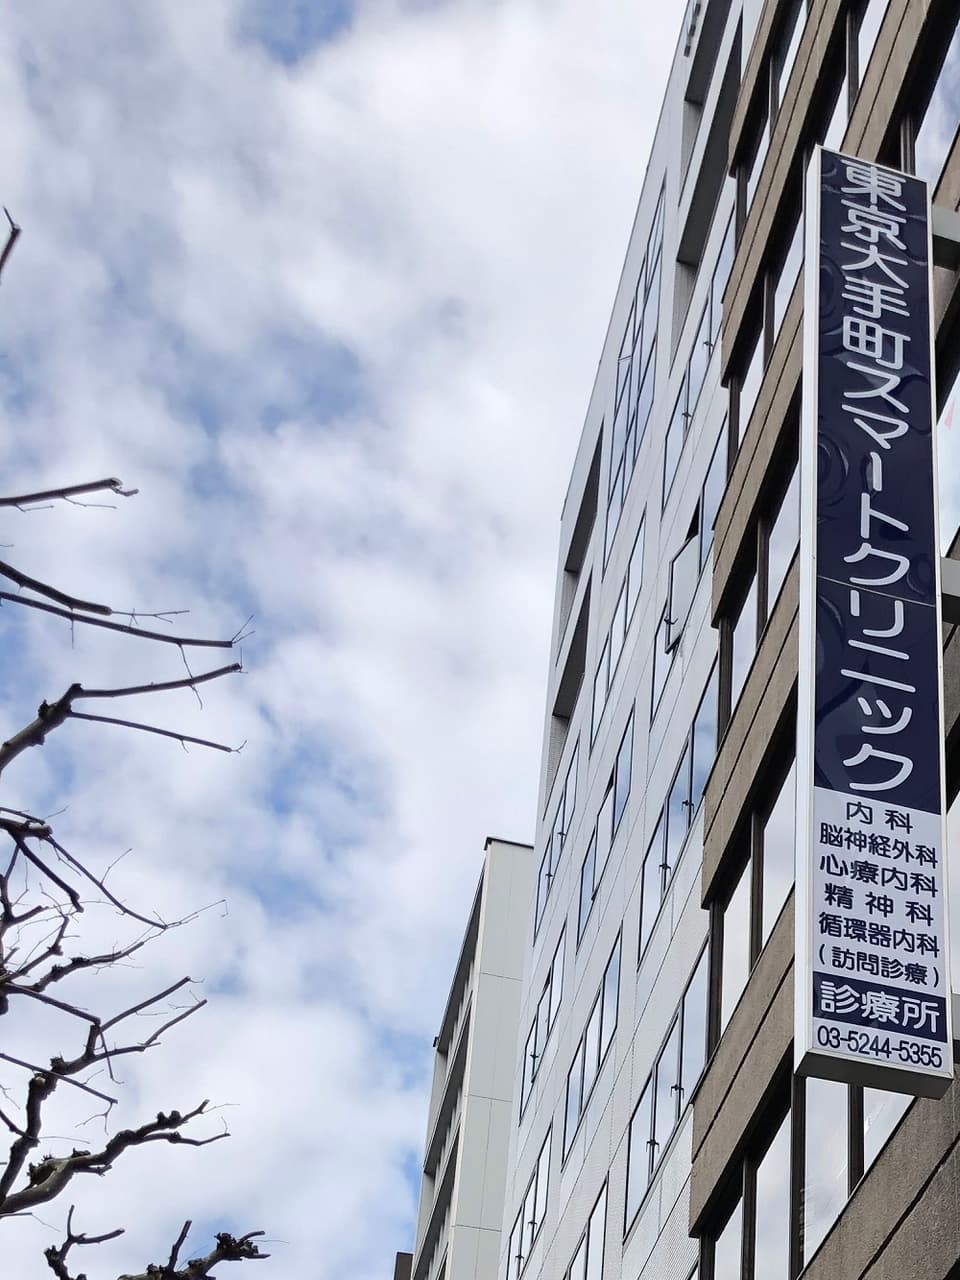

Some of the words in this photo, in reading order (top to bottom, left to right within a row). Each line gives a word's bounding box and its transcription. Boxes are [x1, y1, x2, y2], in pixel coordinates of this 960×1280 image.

[841, 159, 916, 792] 東京大手町スマートクリニック
[846, 801, 914, 834] 内科
[819, 822, 938, 869] 脳神経外科
[819, 854, 938, 898] 心療内科
[824, 882, 934, 927] 精神科
[818, 911, 940, 958] 循環器内科
[820, 981, 940, 1034] 診療所
[817, 1025, 943, 1068] 03-5244-5355
